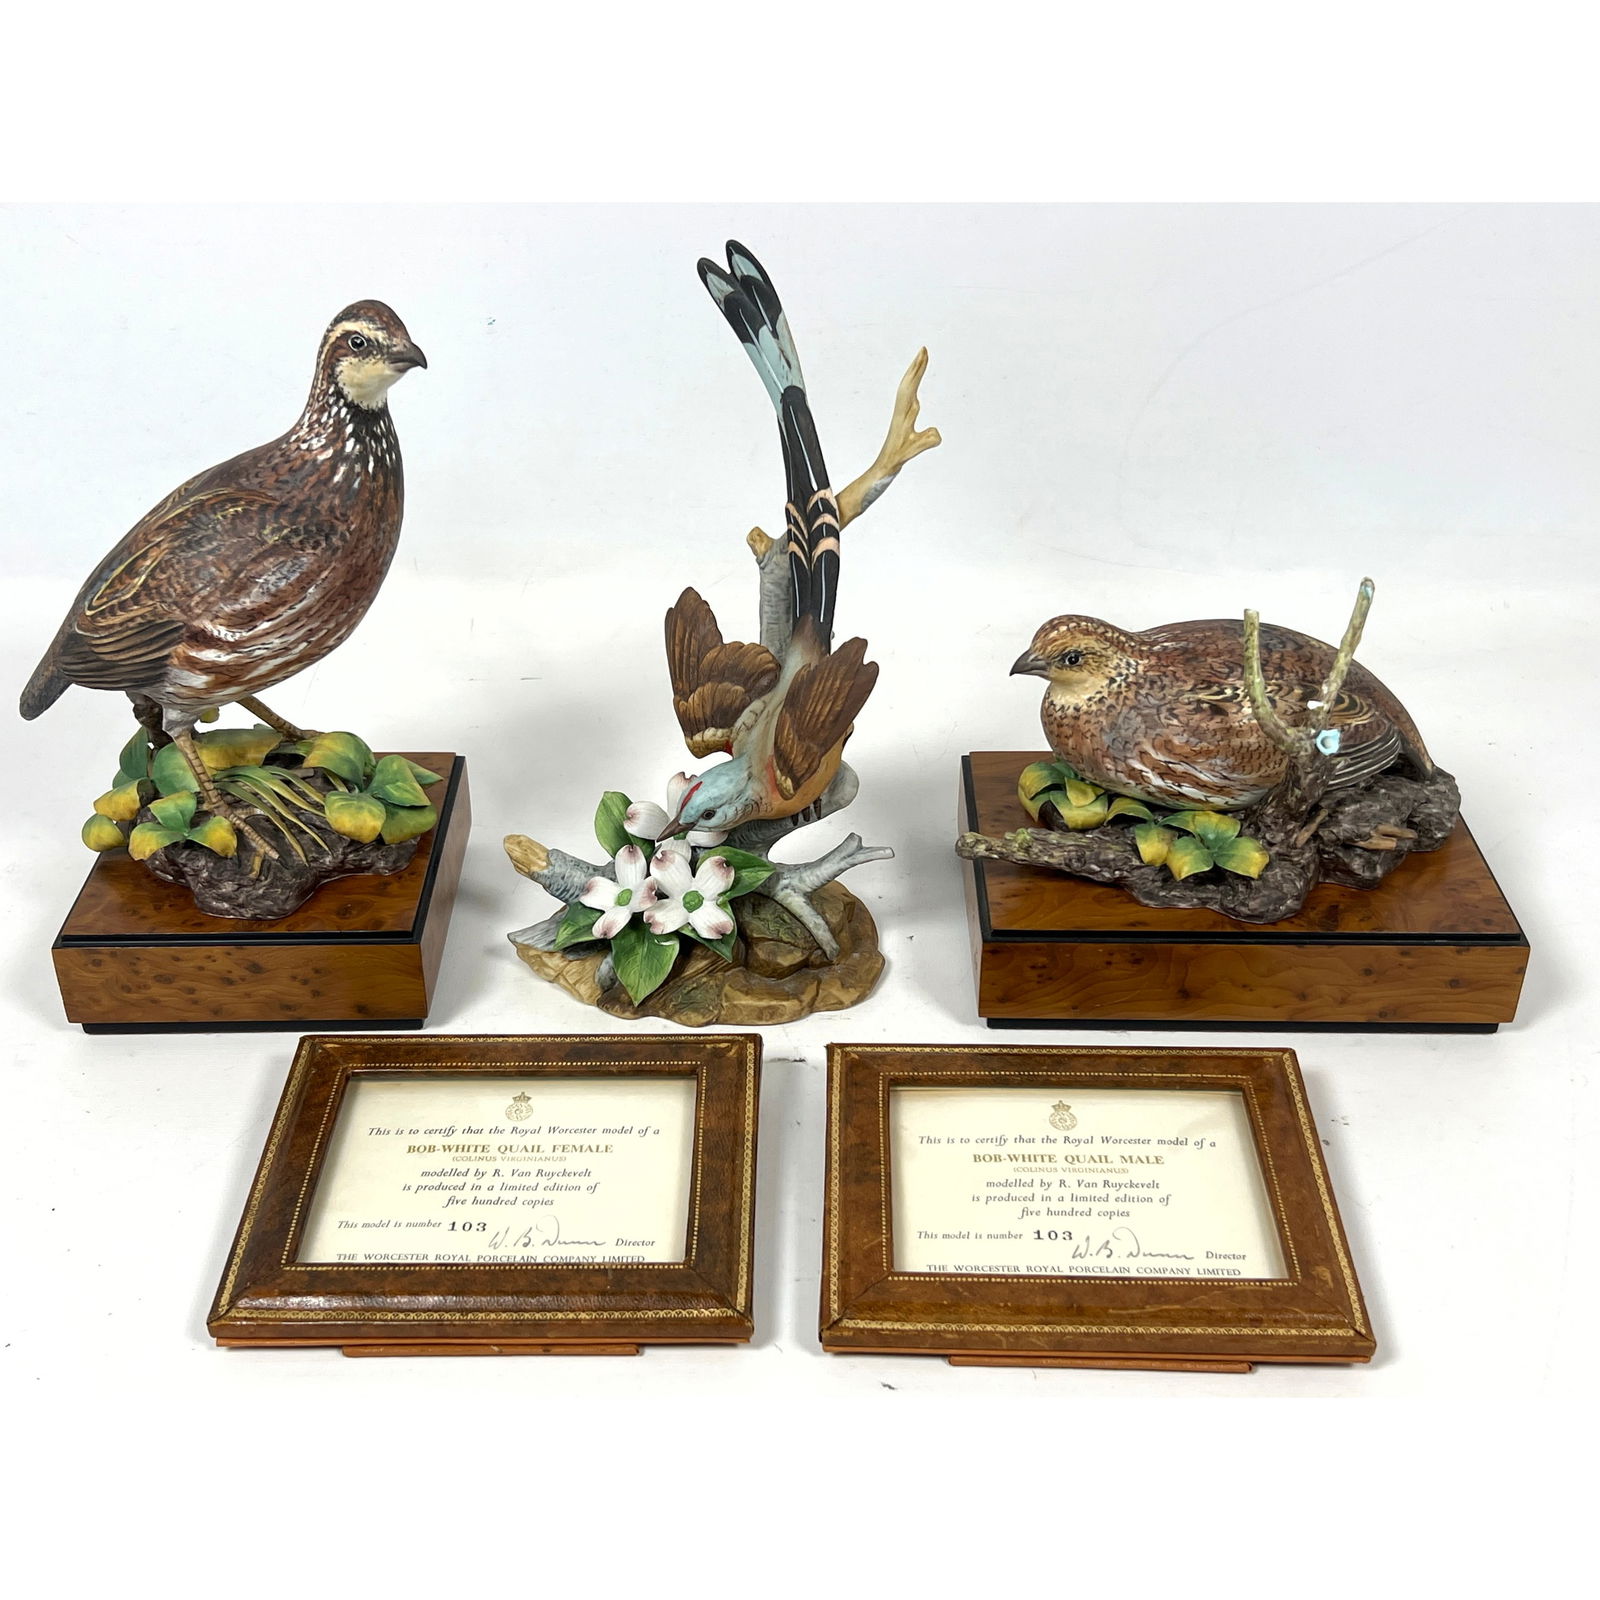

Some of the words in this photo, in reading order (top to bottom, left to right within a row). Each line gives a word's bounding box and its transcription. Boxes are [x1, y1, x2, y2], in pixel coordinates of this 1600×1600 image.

[368, 1127, 390, 1136] This
[424, 1126, 457, 1137] certify
[462, 1127, 483, 1135] that
[489, 1126, 505, 1135] the
[511, 1126, 541, 1137] Royal
[548, 1126, 597, 1135] Worcester
[602, 1126, 633, 1135] model
[638, 1126, 651, 1137] of
[918, 1136, 941, 1144] This
[975, 1135, 1008, 1146] certify
[1014, 1135, 1035, 1143] that
[1041, 1135, 1057, 1144] the
[1063, 1136, 1094, 1147] Royal
[1101, 1136, 1151, 1145] Worcester
[1157, 1138, 1188, 1146] model
[1193, 1138, 1206, 1150] of
[407, 1144, 490, 1154] BOB-WHITE
[498, 1144, 544, 1154] QUAIL
[552, 1144, 613, 1153] FEMALE
[973, 1154, 1057, 1163] BOB-WHITE
[1064, 1155, 1113, 1165] QUAIL
[1120, 1155, 1164, 1164] MALE
[421, 1168, 469, 1177] modelled
[474, 1168, 487, 1180] by
[492, 1169, 504, 1177] R.
[510, 1169, 531, 1177] Van
[535, 1169, 592, 1180] Ruyckevelt
[402, 1183, 411, 1191] is
[415, 1182, 466, 1193] produced
[471, 1183, 481, 1191] in
[500, 1183, 539, 1191] limited
[543, 1183, 581, 1191] edition
[587, 1182, 600, 1194] of
[986, 1179, 1034, 1188] modelled
[1040, 1179, 1052, 1190] by
[1059, 1180, 1071, 1188] R.
[1077, 1180, 1098, 1188] Van
[1102, 1180, 1159, 1191] Ruyckevelt
[442, 1196, 467, 1208] five
[472, 1197, 517, 1206] hundred
[522, 1199, 554, 1208] copies
[972, 1194, 980, 1202] is
[985, 1193, 1035, 1204] produced
[1041, 1194, 1052, 1202] in
[1071, 1193, 1109, 1202] limited
[1115, 1194, 1153, 1202] edition
[1159, 1194, 1172, 1206] of
[1017, 1207, 1041, 1219] five
[1047, 1207, 1092, 1217] hundred
[1098, 1210, 1130, 1220] copies
[338, 1220, 358, 1228] This
[361, 1220, 390, 1228] model
[406, 1219, 442, 1228] number
[448, 1221, 487, 1232] 103
[917, 1231, 938, 1239] This
[942, 1231, 970, 1239] model
[987, 1231, 1023, 1239] number
[1033, 1230, 1073, 1241] 103
[615, 1238, 655, 1247] Director
[364, 1253, 428, 1261] WORCESTER
[1205, 1251, 1246, 1260] Director
[1136, 1267, 1191, 1275] COMPANY
[1197, 1268, 1241, 1276] LIMITED
